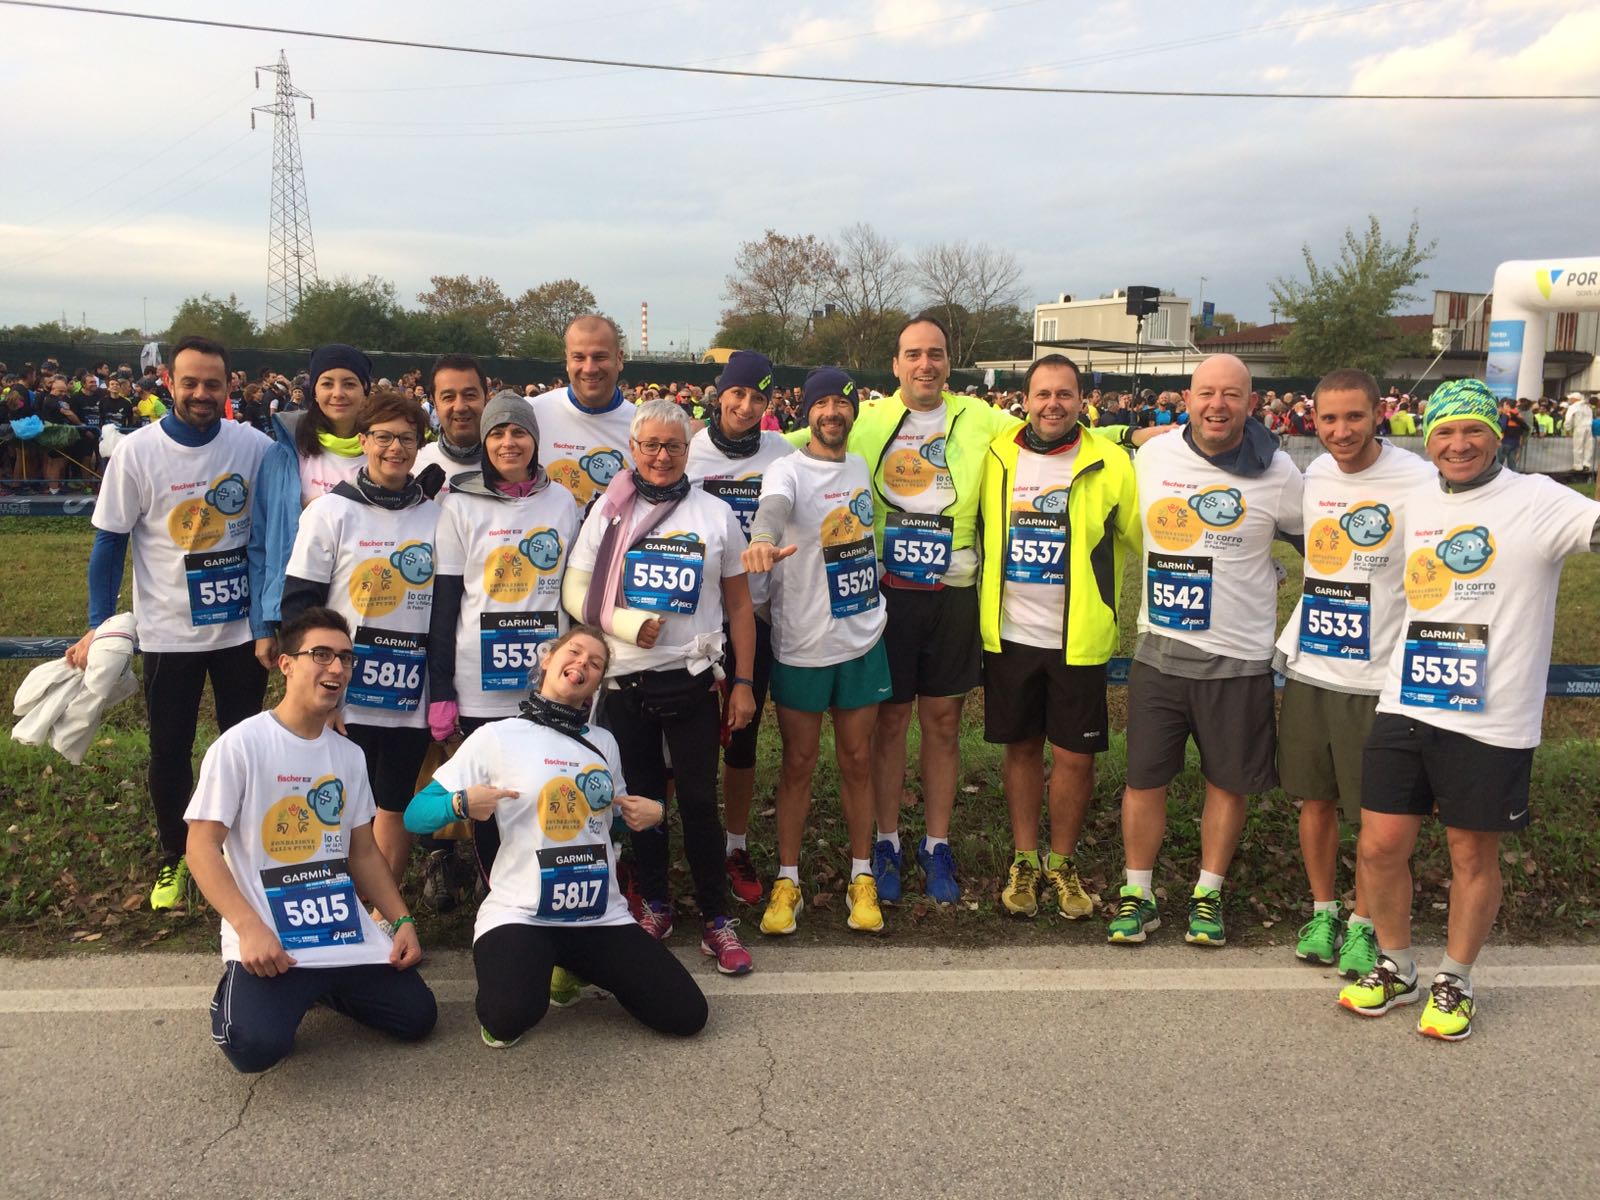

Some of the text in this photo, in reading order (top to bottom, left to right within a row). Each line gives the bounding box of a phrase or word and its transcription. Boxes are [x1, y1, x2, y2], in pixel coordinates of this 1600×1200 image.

[1567, 272, 1598, 286] POR
[1162, 480, 1186, 489] fischer
[901, 519, 939, 528] GARMIN
[1018, 518, 1057, 526] GARMIN
[1216, 534, 1243, 543] corro
[645, 544, 687, 552] GARMIN
[840, 547, 867, 558] GARMIN
[893, 540, 946, 565] 5532
[1011, 540, 1066, 564] 5537
[204, 555, 240, 567] GARMIN
[1157, 561, 1195, 570] GARMIN
[633, 563, 696, 592] 5530
[838, 566, 874, 596] 5529
[200, 575, 249, 605] 5538
[1153, 582, 1204, 610] 5542
[1315, 586, 1352, 597] GARMIN
[1309, 609, 1362, 638] 5533
[374, 636, 417, 648] GARMIN
[1420, 630, 1466, 640] GARMIN
[362, 660, 420, 689] 5816
[1411, 655, 1477, 687] 5535
[555, 854, 594, 865] GARMIN
[282, 869, 331, 884] GARMIN
[552, 880, 602, 911] 5817
[284, 893, 349, 927] 5815
